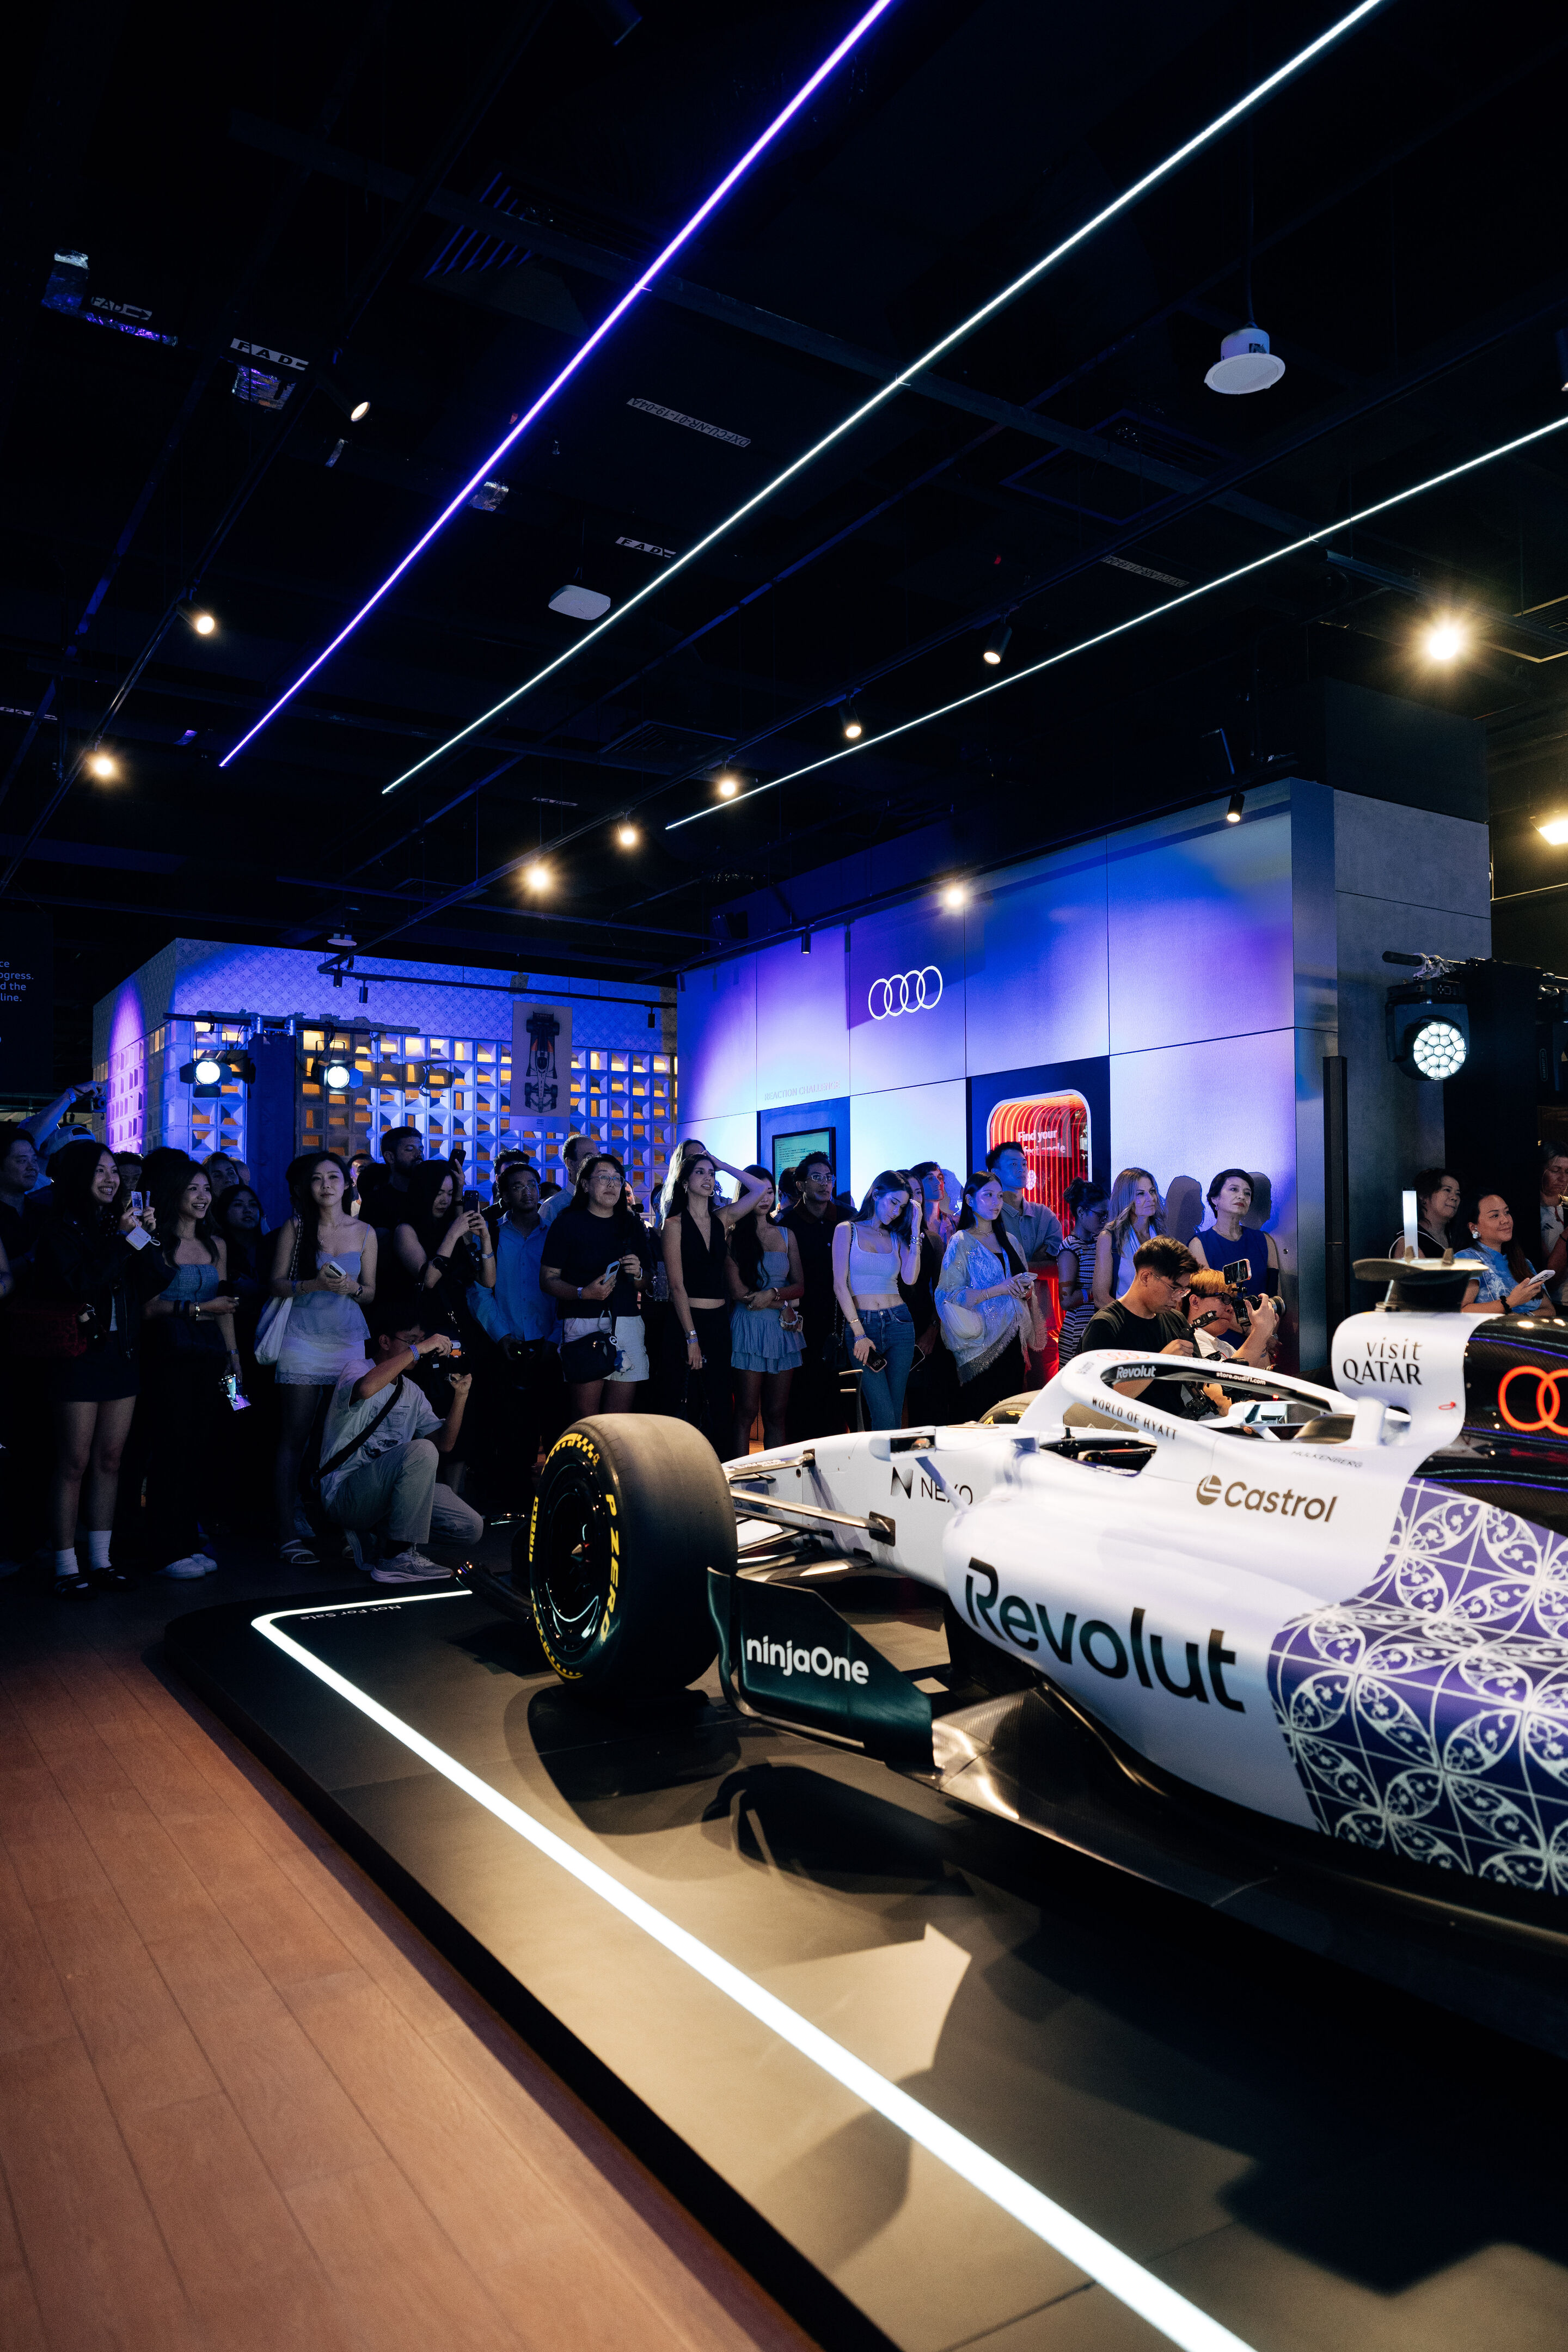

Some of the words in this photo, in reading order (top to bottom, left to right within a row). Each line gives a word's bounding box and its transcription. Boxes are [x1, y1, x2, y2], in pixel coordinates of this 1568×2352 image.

[237, 341, 293, 365] FAD
[632, 398, 750, 446] DXFCU-NR-01-19-04A
[621, 538, 661, 553] FAD
[1, 993, 22, 1001] line.
[9, 982, 26, 990] the
[764, 1088, 798, 1101] REACTION
[799, 1081, 841, 1095] CHALLENGE
[1018, 1130, 1036, 1142] Find
[1037, 1130, 1058, 1143] your
[1024, 1145, 1039, 1157] fect
[1041, 1143, 1065, 1157] angle
[1367, 1337, 1423, 1361] visit
[1116, 1365, 1156, 1379] Revolut
[1216, 1371, 1266, 1386] store.audif1.com
[1343, 1359, 1423, 1385] QATAR
[1092, 1396, 1123, 1418] WORLD
[1127, 1411, 1141, 1424] OF
[1144, 1418, 1179, 1440] HYATT
[605, 1494, 617, 1516] P
[1225, 1481, 1338, 1522] Castrol
[601, 1527, 620, 1642] ZERO
[965, 1557, 1246, 1713] Revolut
[746, 1635, 869, 1685] ninjaOne
